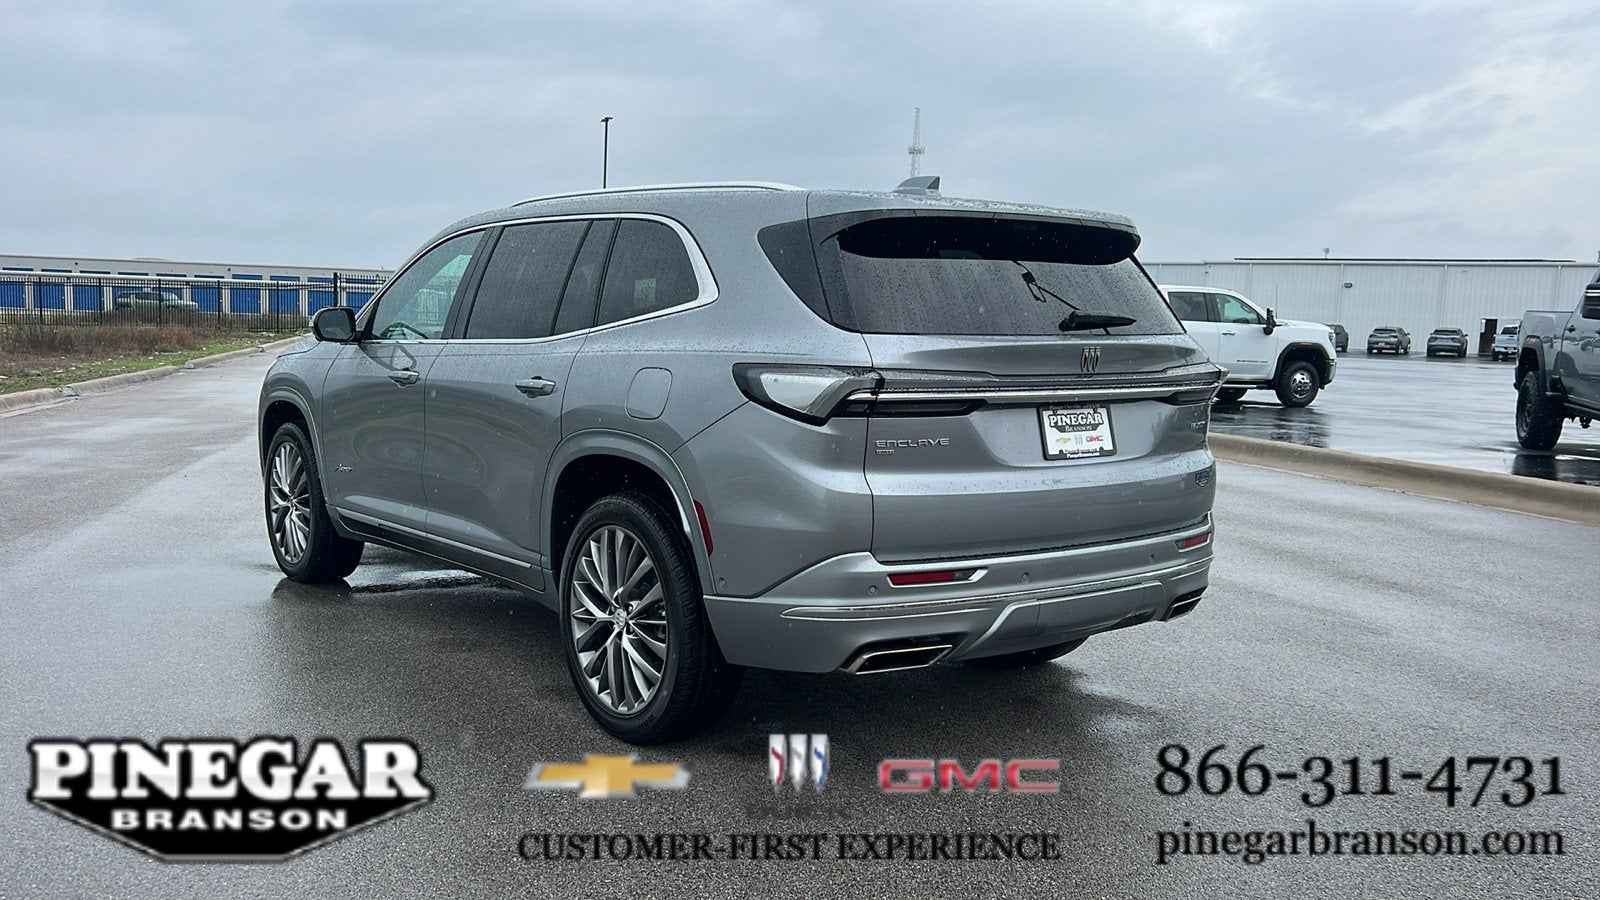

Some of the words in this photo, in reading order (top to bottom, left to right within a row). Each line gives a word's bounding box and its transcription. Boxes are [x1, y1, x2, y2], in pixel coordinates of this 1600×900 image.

[1049, 413, 1103, 427] PINEGAR
[875, 437, 950, 448] ENCLAVE
[1086, 435, 1104, 443] GMC
